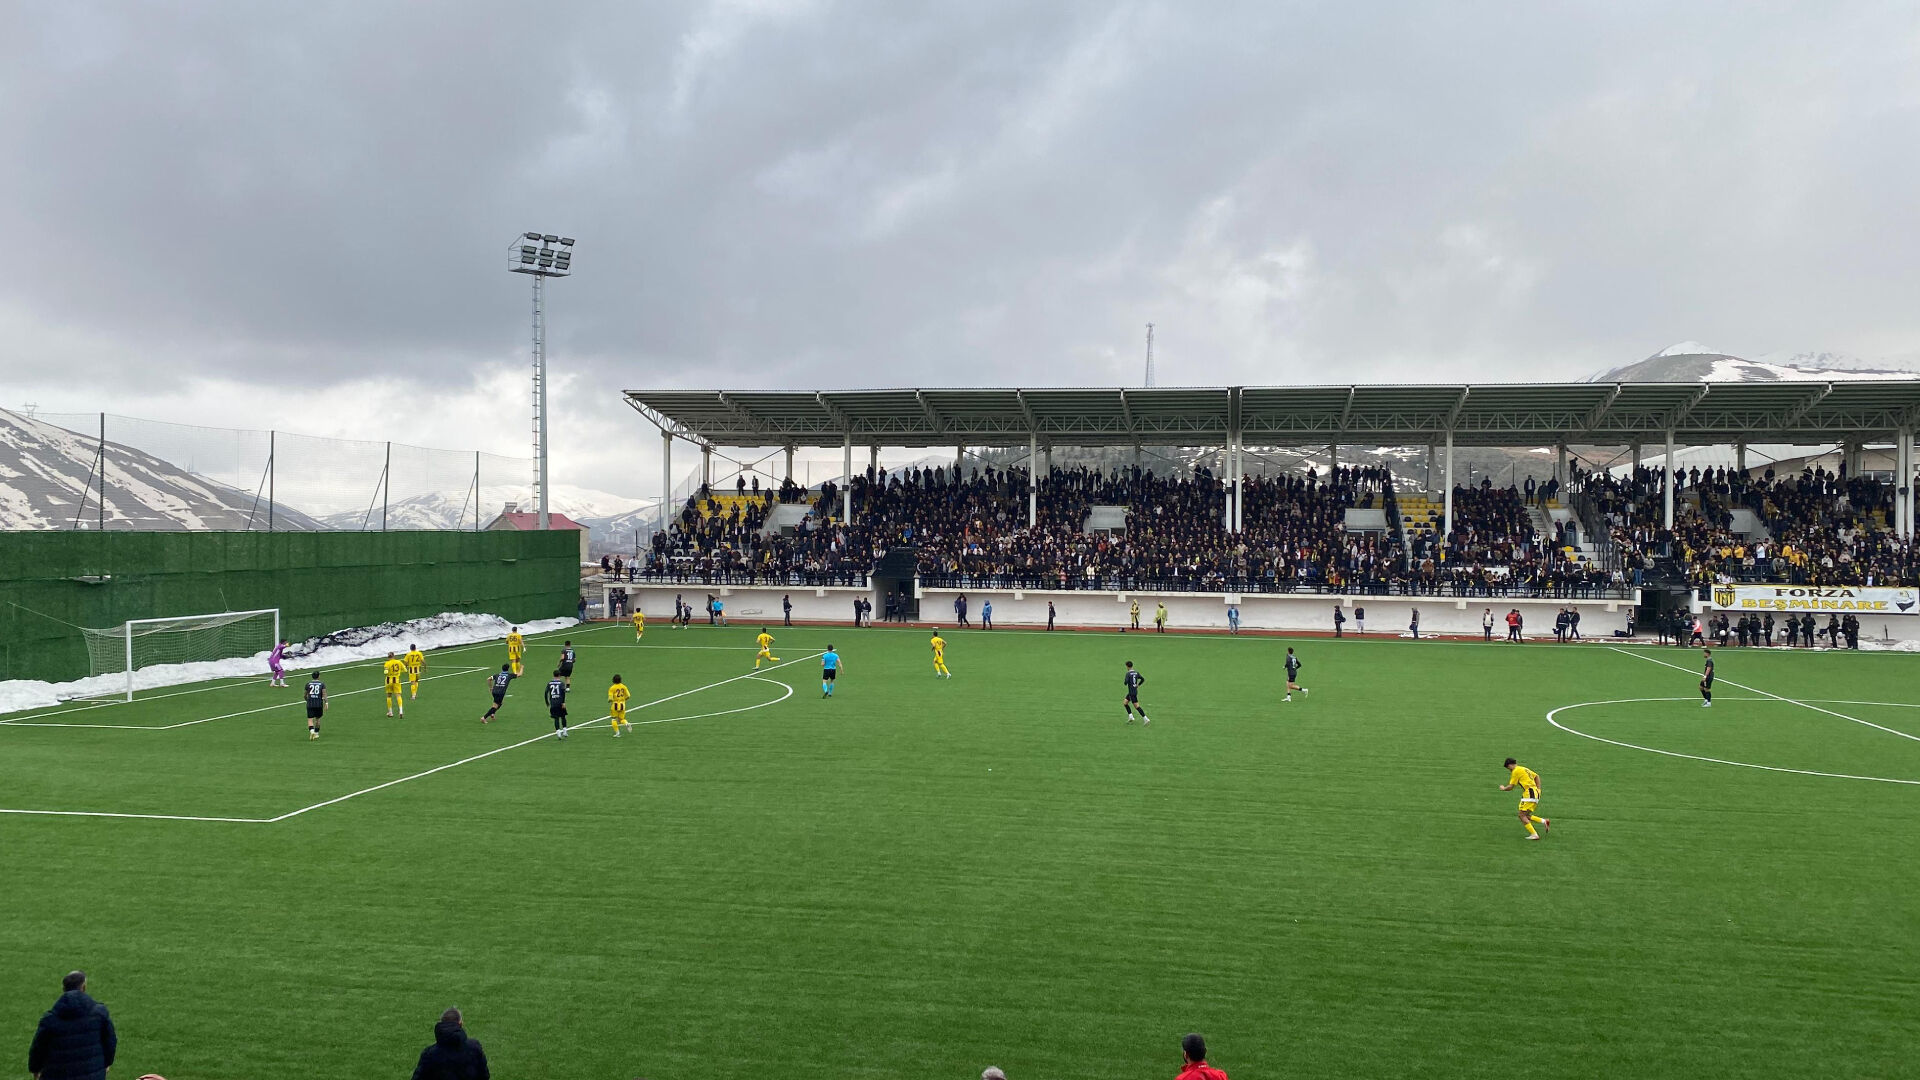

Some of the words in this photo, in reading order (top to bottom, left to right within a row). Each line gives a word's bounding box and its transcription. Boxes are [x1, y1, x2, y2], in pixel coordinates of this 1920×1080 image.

[1775, 588, 1855, 597] FORZA
[1741, 598, 1889, 611] BEŞMİNARE
[391, 664, 399, 672] 13
[309, 684, 319, 695] 28
[550, 684, 560, 695] 21
[616, 688, 624, 698] 23
